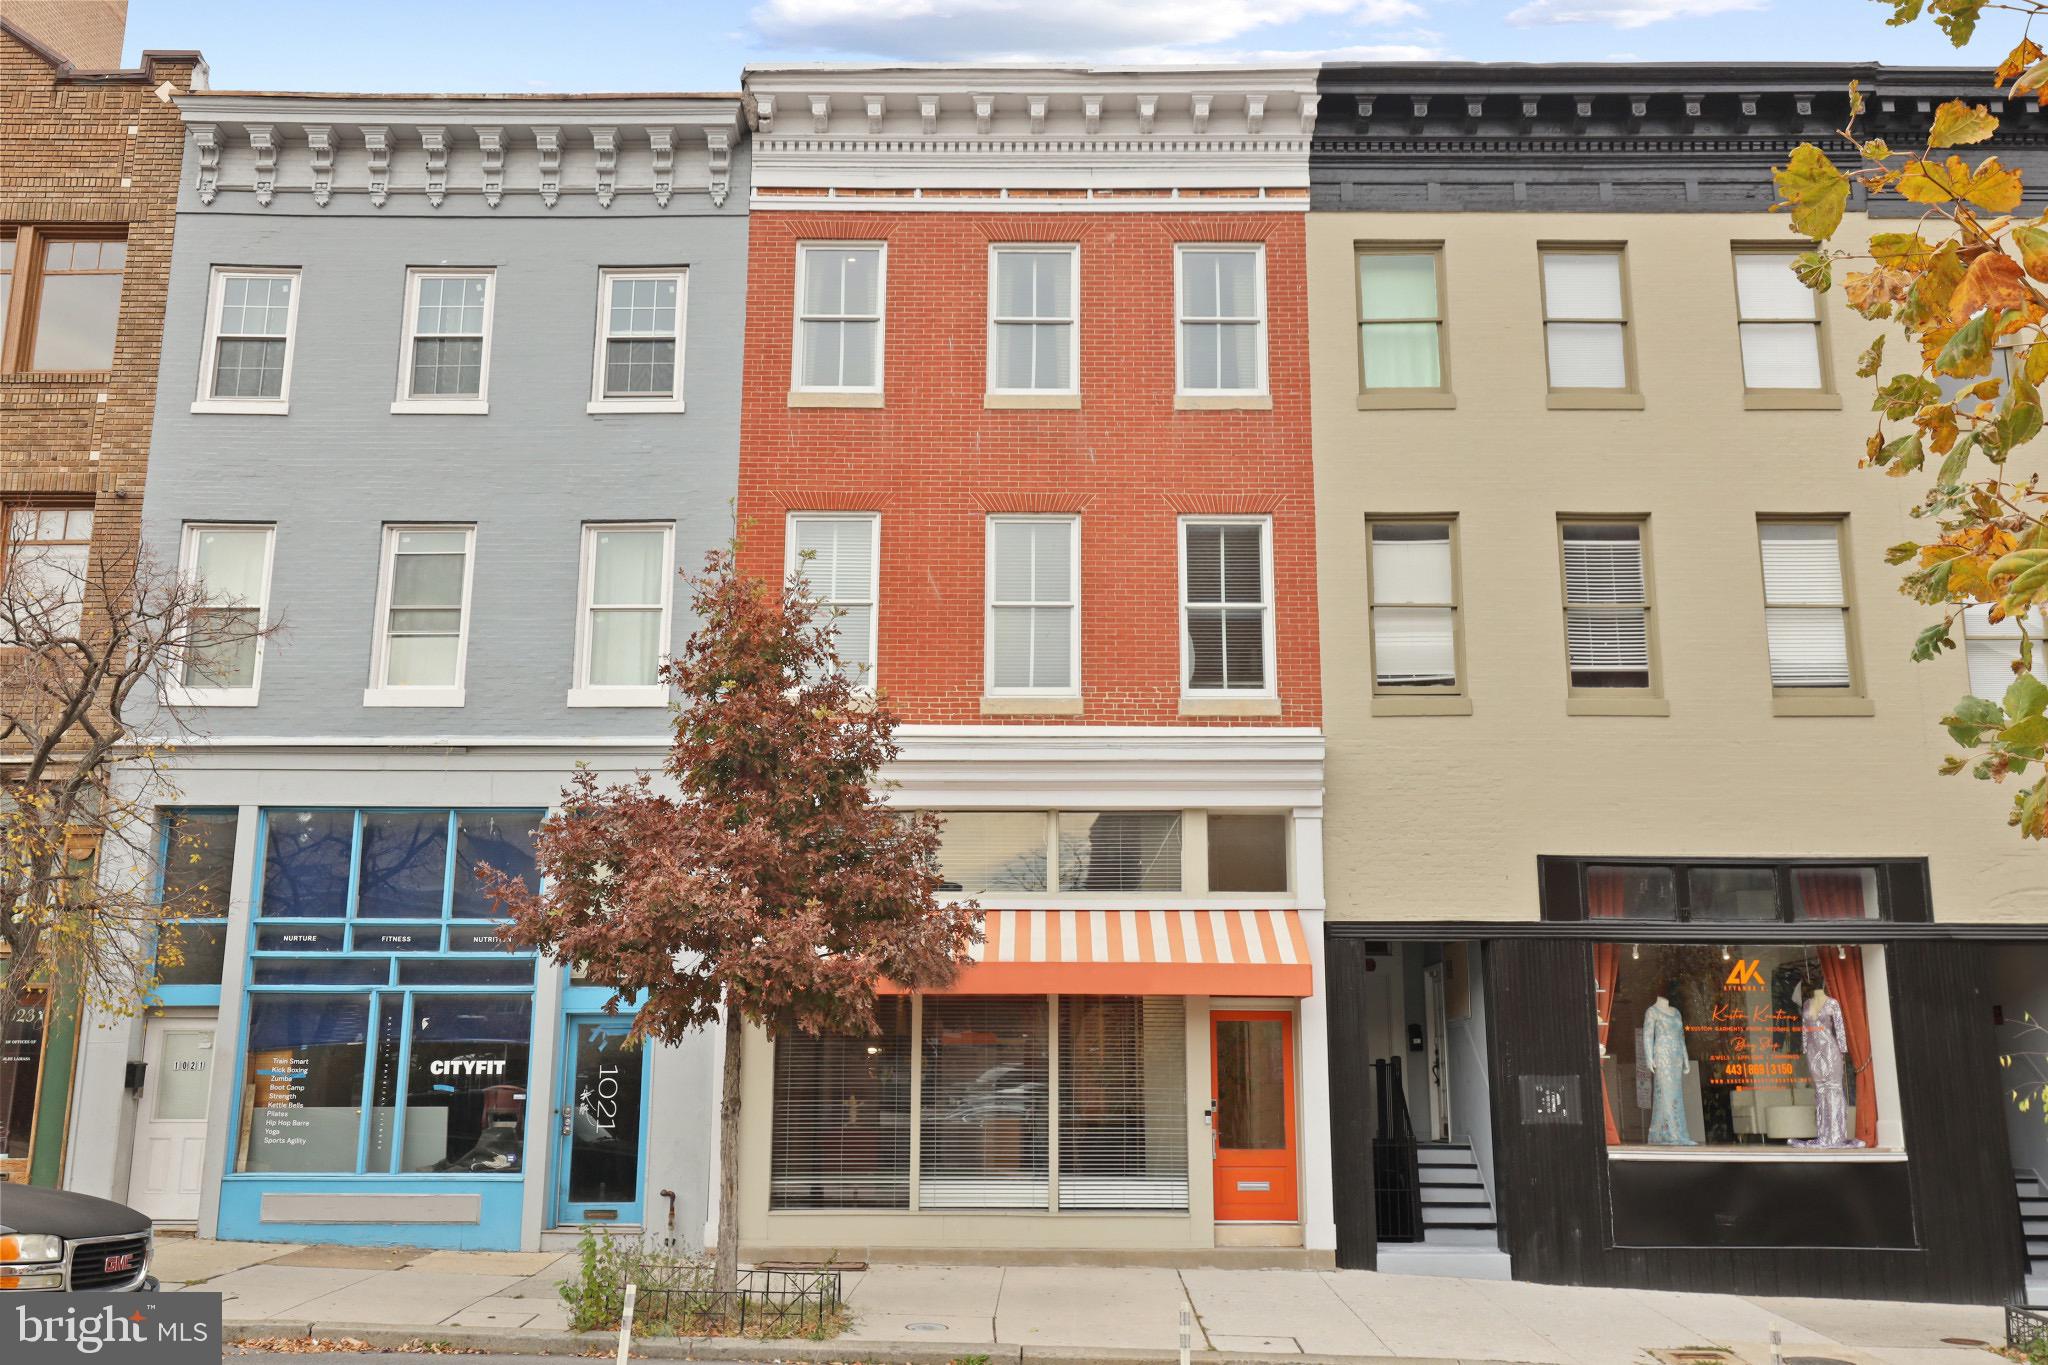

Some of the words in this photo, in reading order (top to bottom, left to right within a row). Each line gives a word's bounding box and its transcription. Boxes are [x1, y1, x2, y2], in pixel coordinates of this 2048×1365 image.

[175, 1061, 204, 1070] 1021
[273, 1057, 288, 1065] Train
[286, 1067, 309, 1075] Boxing
[430, 1060, 506, 1075] CITYFIT
[269, 1093, 297, 1101] Strength
[596, 1064, 619, 1134] 1021
[265, 1128, 280, 1136] Yoga
[264, 1137, 285, 1145] Sports
[286, 1138, 307, 1146] Agility
[104, 1254, 133, 1273] GMC
